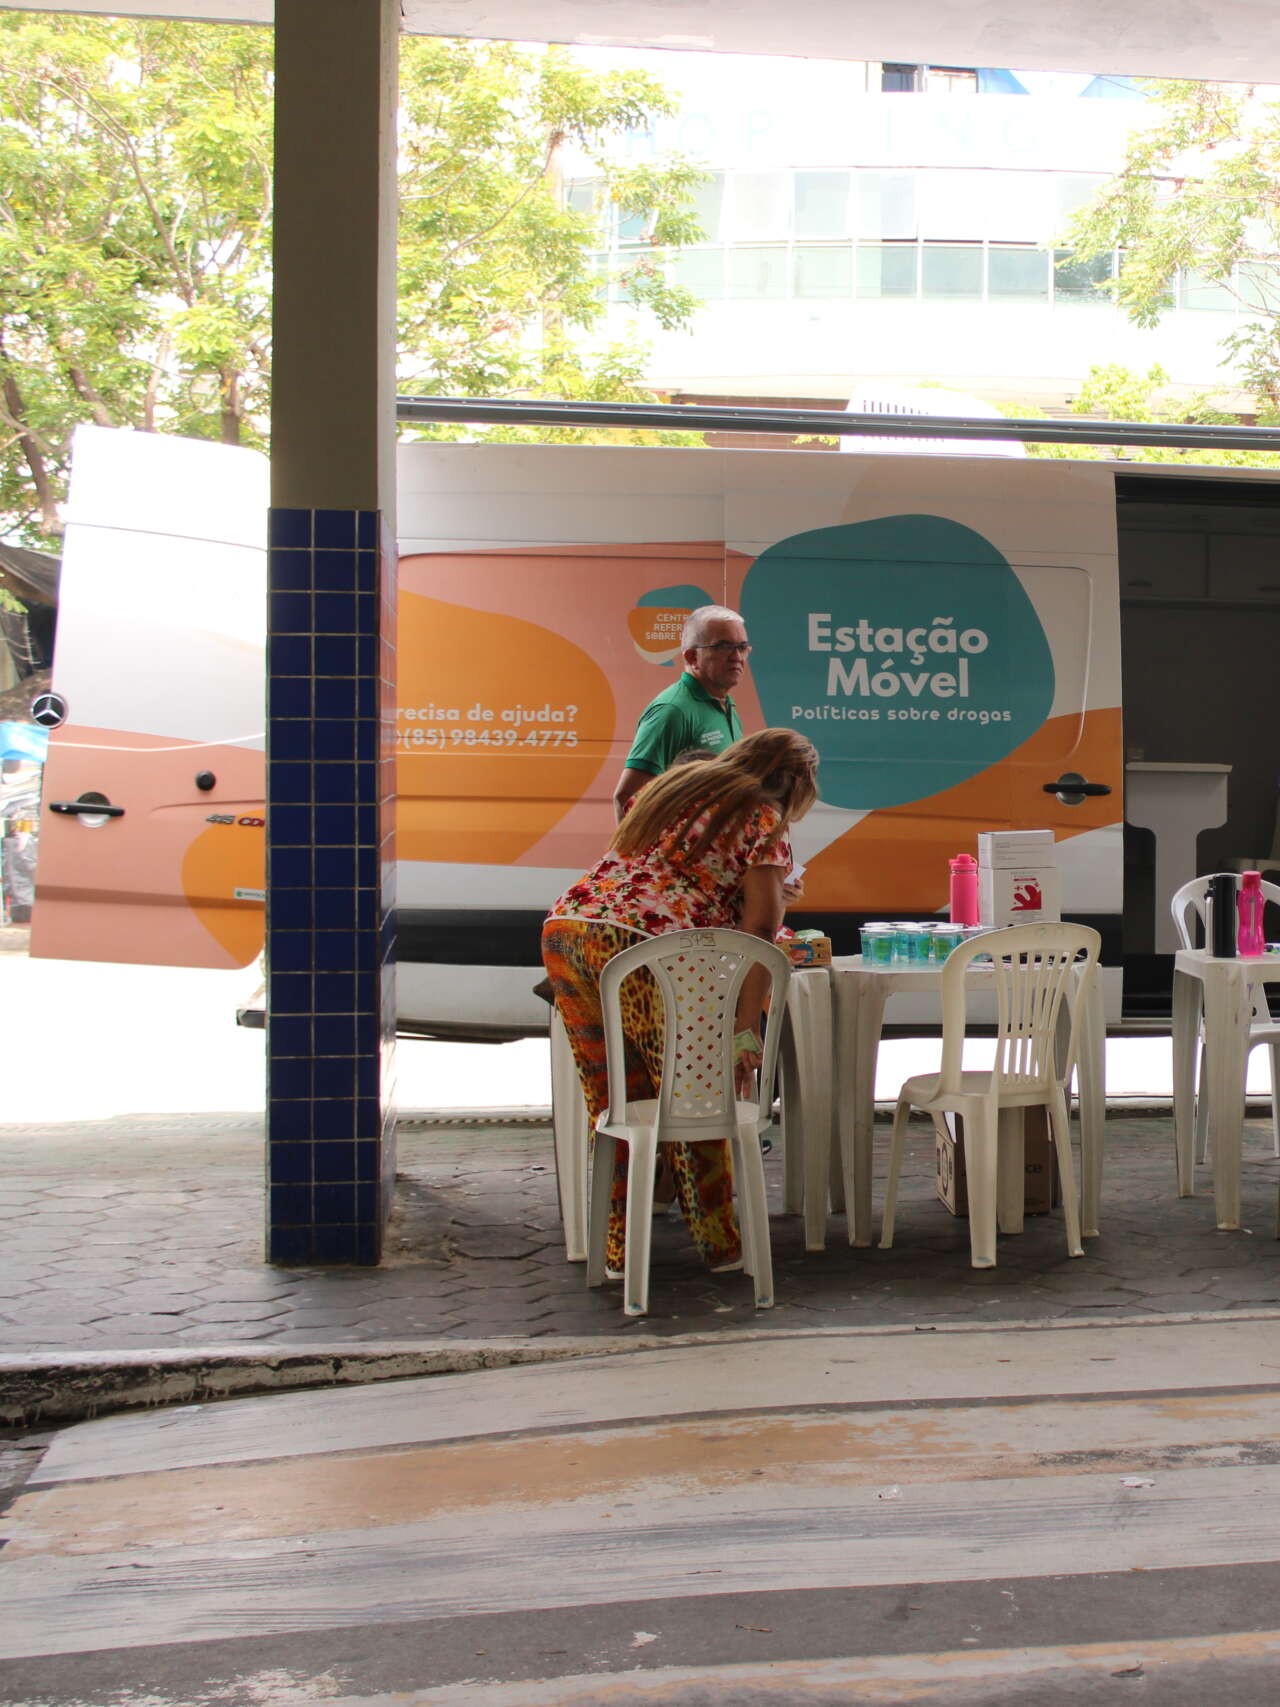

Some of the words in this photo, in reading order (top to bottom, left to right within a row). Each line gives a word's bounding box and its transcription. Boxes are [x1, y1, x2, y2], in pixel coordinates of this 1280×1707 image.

[656, 613, 689, 622] CENTR
[808, 613, 989, 665] Estação
[826, 657, 969, 697] Móvel
[396, 703, 460, 721] recisa
[467, 703, 494, 721] de
[501, 704, 578, 727] ajuda?
[791, 705, 880, 720] Políticas
[887, 707, 941, 721] sobre
[947, 707, 1012, 725] drogas
[404, 728, 446, 750] (85)
[450, 729, 578, 747] 98439.4775
